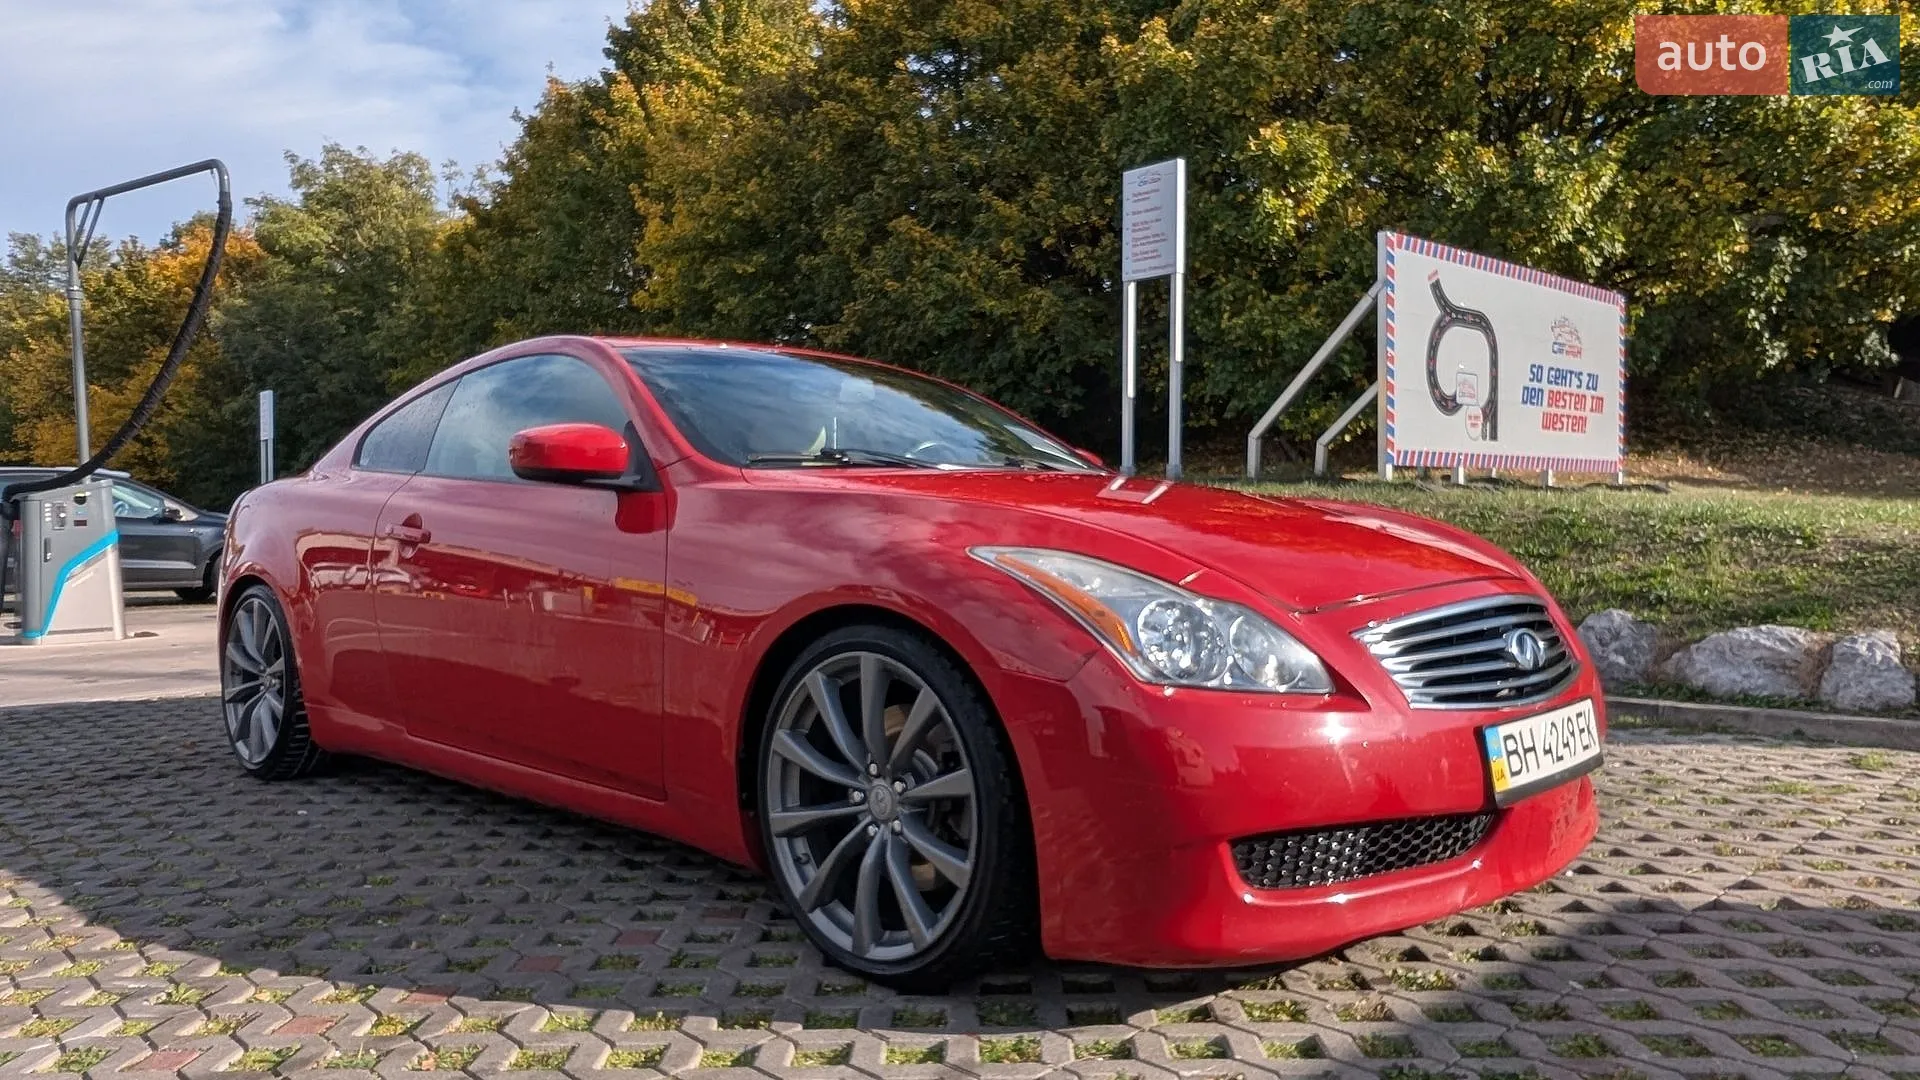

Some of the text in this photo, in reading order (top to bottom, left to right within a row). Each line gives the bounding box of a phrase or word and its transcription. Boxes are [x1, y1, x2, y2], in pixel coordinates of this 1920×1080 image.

[1529, 364, 1543, 382] SO
[1586, 374, 1598, 391] ZU
[1522, 387, 1604, 413] DEN BESTEN IM
[1542, 412, 1587, 433] WESTEN!
[1503, 708, 1596, 777] BH 4249 EK
[1495, 768, 1506, 782] UA
